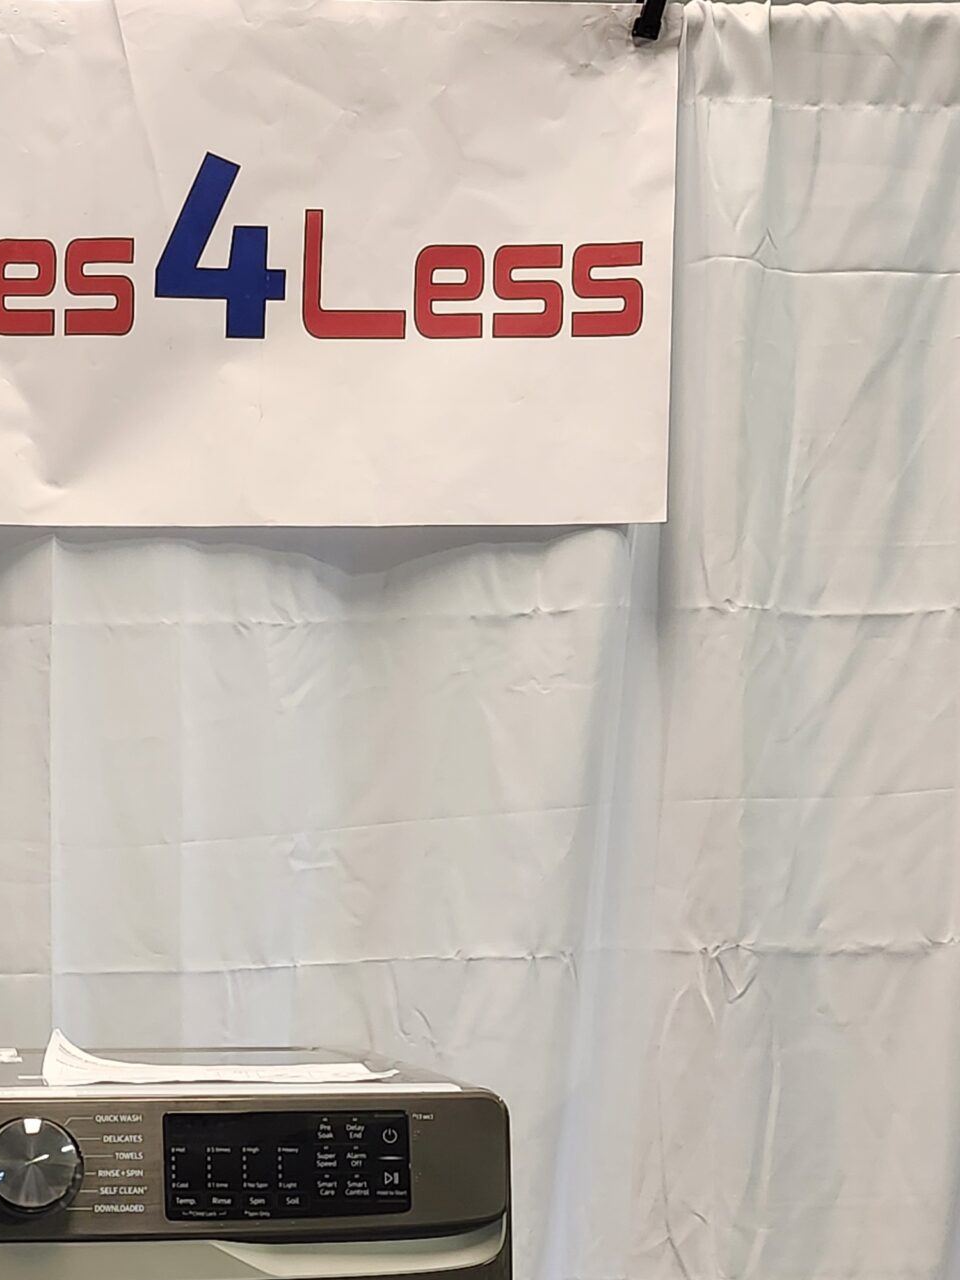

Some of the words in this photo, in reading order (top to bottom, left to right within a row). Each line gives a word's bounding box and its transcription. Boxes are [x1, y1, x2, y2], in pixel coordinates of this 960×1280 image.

[95, 1115, 119, 1123] QUICK
[346, 1124, 365, 1132] Delay
[115, 1152, 143, 1160] TOWELS
[317, 1152, 336, 1160] Super
[316, 1160, 337, 1168] Speed
[98, 1169, 120, 1177] RINSE
[126, 1169, 144, 1177] SPIN
[100, 1187, 118, 1195] SELF
[212, 1197, 232, 1205] Rinse
[249, 1197, 265, 1205] Spin
[94, 1205, 145, 1213] DOWNLOADED
